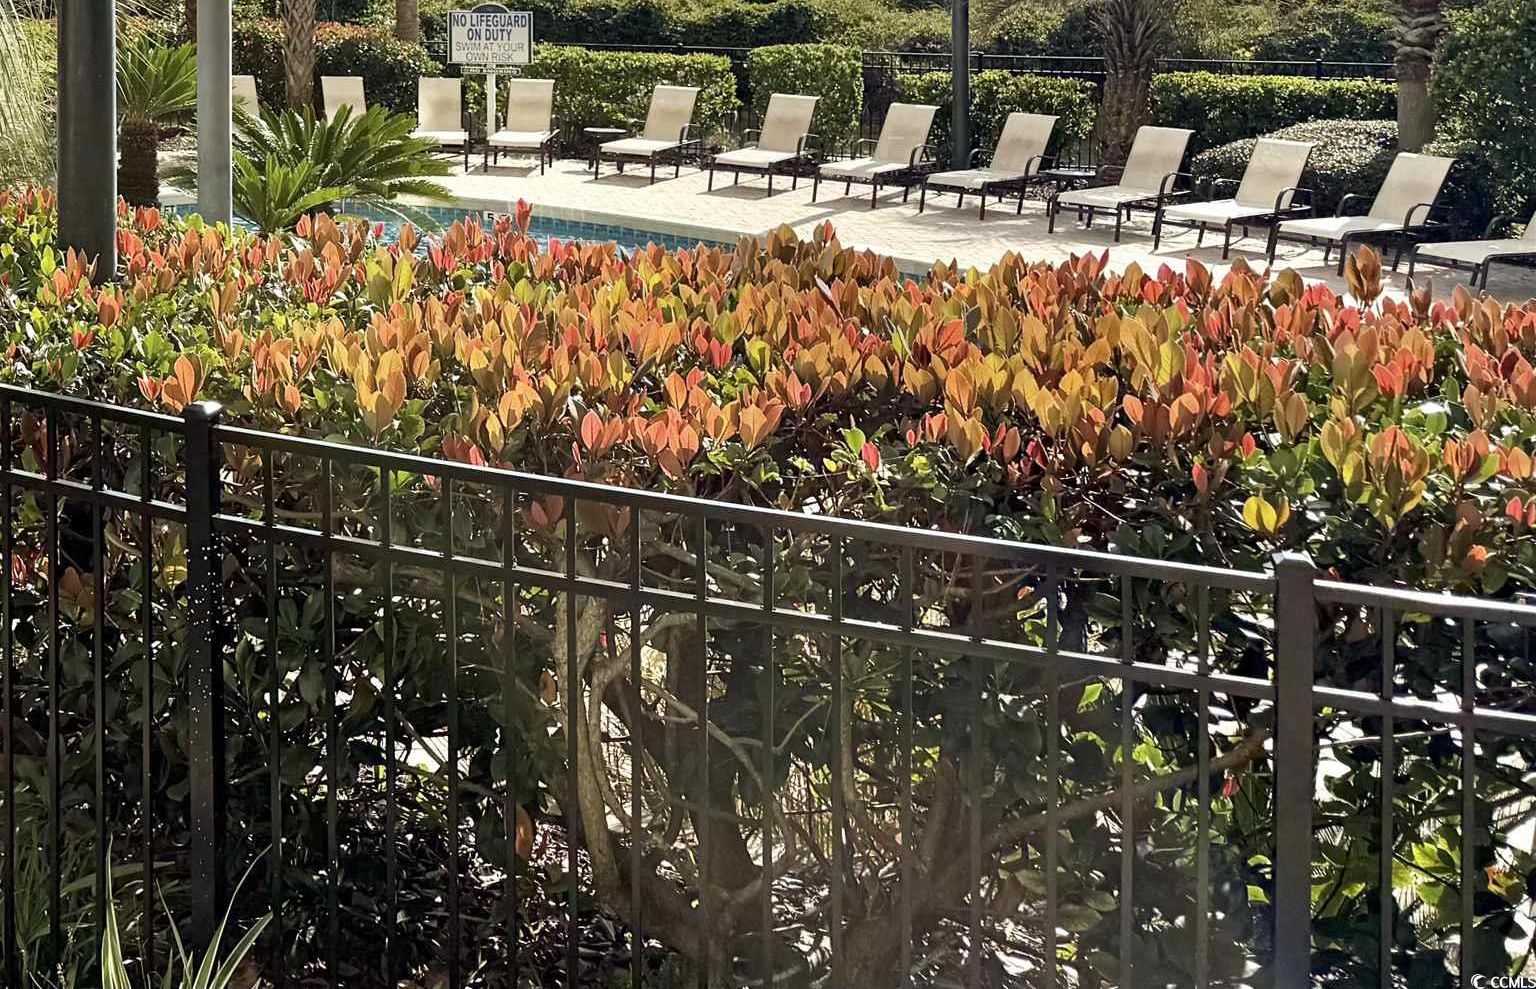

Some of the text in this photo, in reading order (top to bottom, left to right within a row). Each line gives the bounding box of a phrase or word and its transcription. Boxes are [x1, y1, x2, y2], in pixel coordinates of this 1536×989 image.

[453, 15, 527, 27] NO LIFEGUARD
[467, 29, 512, 41] ON DUTY
[456, 42, 525, 51] SWIM AT YOUR
[466, 52, 514, 61] OWN RISK
